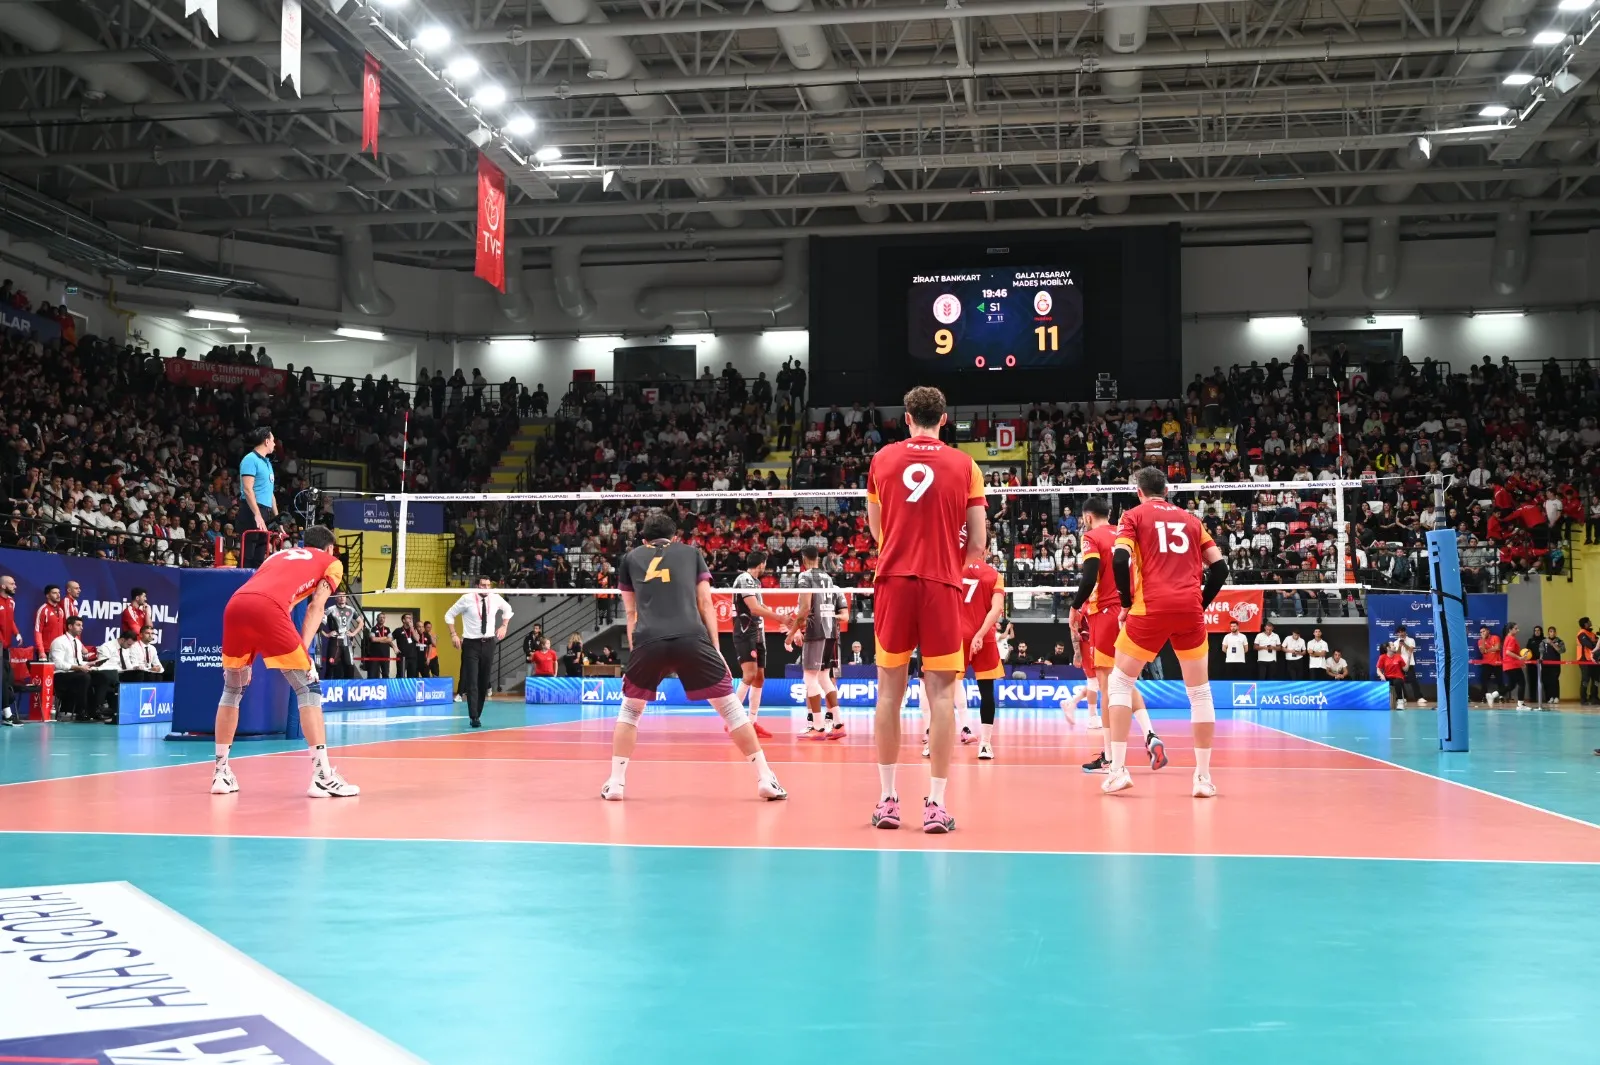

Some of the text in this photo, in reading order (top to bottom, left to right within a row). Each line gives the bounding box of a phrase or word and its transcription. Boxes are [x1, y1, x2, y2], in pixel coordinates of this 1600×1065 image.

[482, 230, 501, 259] TVF
[912, 274, 981, 283] ZİRAAT BANKKART
[1012, 277, 1073, 287] MADEŞ MOBİLYA
[1015, 271, 1071, 280] GALATASARAY
[982, 288, 1007, 298] 19:46
[989, 302, 1000, 312] S1
[934, 325, 1059, 355] 9 11
[975, 354, 1016, 368] 0 0
[999, 429, 1013, 447] D
[906, 443, 943, 451] PATRY
[902, 463, 935, 503] 9
[1154, 520, 1190, 554] 13
[644, 556, 671, 583] 4
[962, 578, 980, 603] 7
[347, 685, 387, 702] KUPASI
[606, 691, 624, 700] AXA
[1260, 693, 1328, 704] AXA SİGORTA
[157, 703, 171, 714] AXA
[48, 962, 208, 1010] AXA
